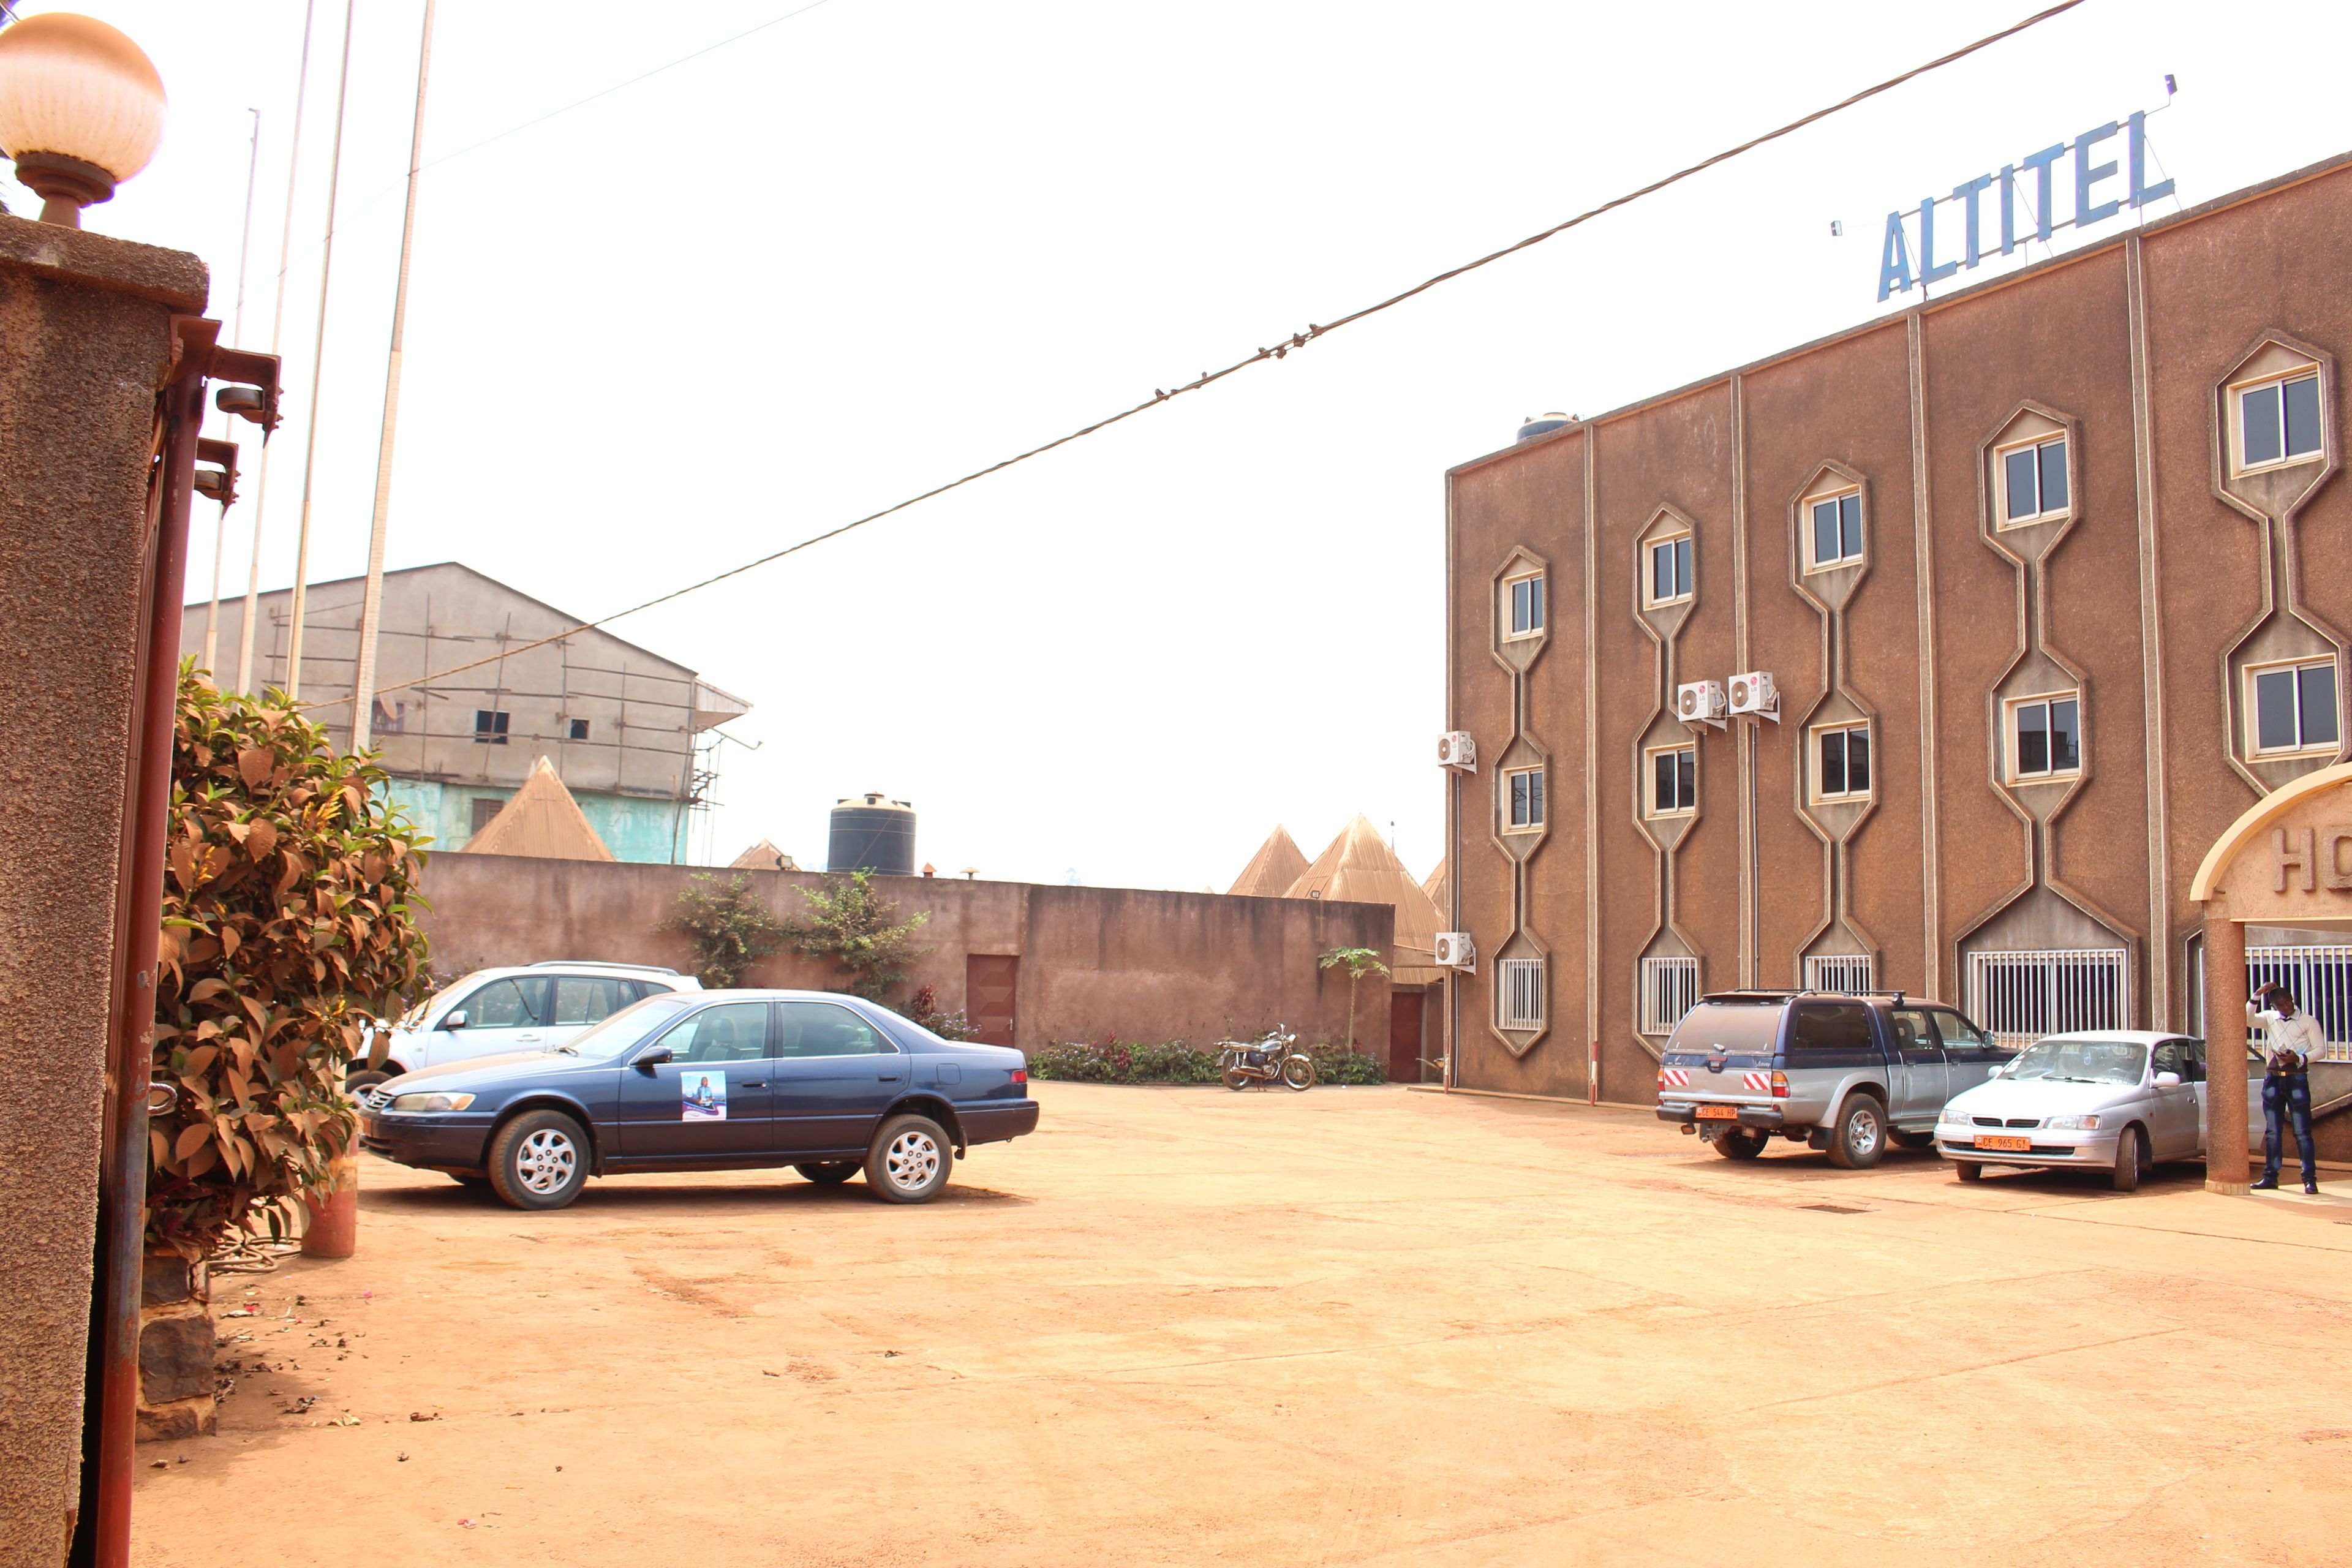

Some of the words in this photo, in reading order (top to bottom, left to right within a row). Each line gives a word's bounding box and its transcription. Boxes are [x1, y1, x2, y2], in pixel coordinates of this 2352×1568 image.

[1877, 110, 2176, 302] ALTITEL
[1703, 1108, 1709, 1117] CE
[1713, 1109, 1724, 1117] 544
[1727, 1109, 1735, 1117] HP
[1983, 1137, 1992, 1147] CE
[1999, 1139, 2011, 1148] 965
